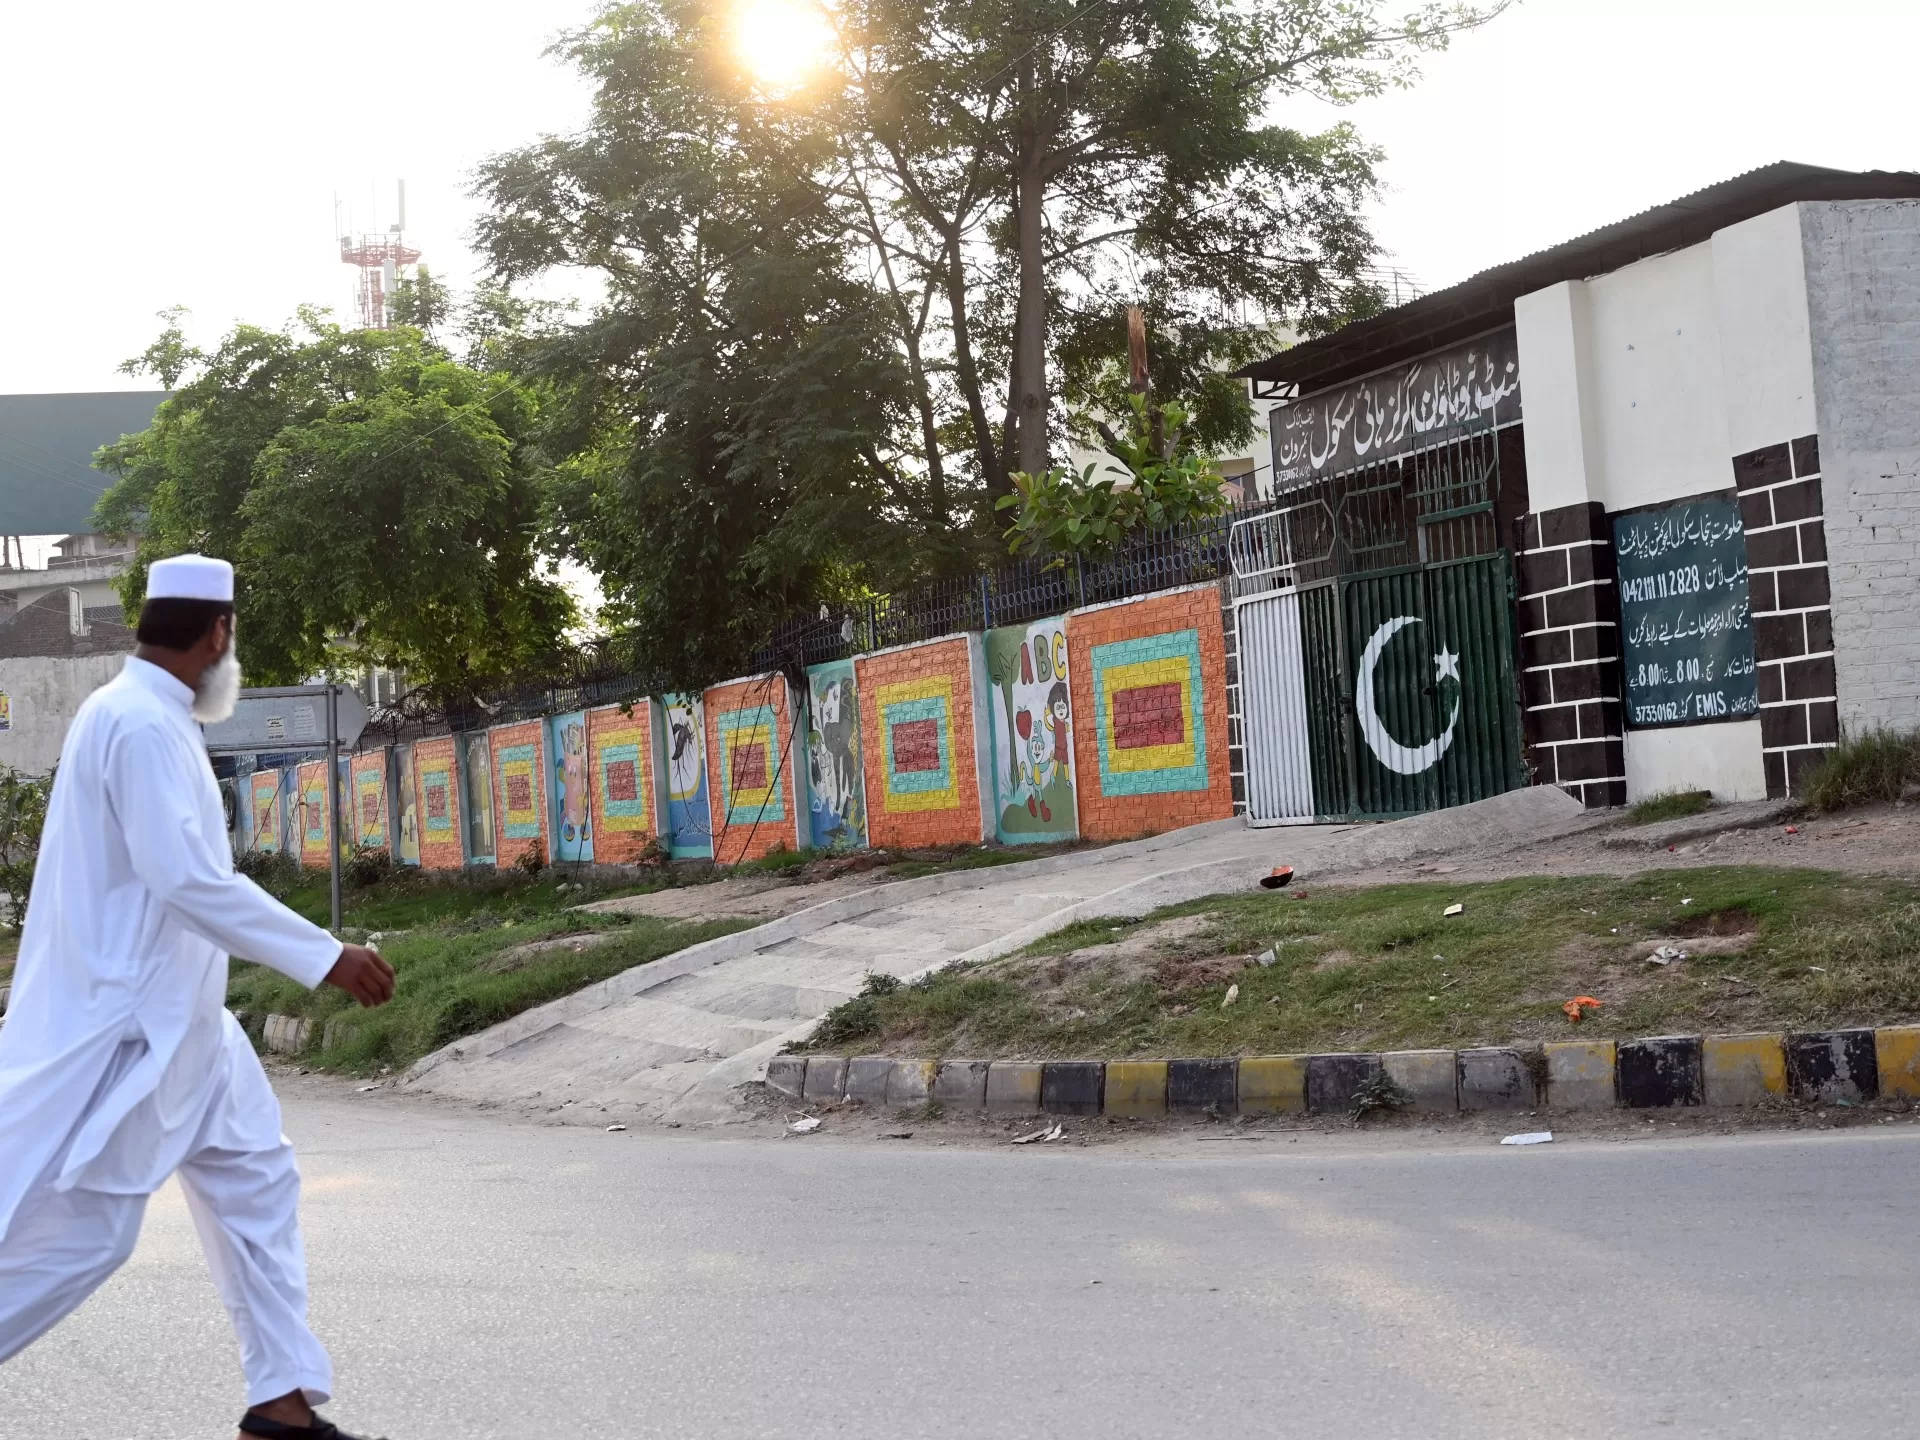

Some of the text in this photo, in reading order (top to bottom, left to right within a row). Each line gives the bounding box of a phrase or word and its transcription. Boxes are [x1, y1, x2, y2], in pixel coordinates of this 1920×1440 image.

[1310, 392, 1355, 469] سکول
[1671, 508, 1695, 549] سکول
[1687, 514, 1714, 548] پنجاب
[1020, 630, 1066, 686] ABC
[1635, 701, 1679, 722] 37330162
[1695, 690, 1726, 717] EMIS
